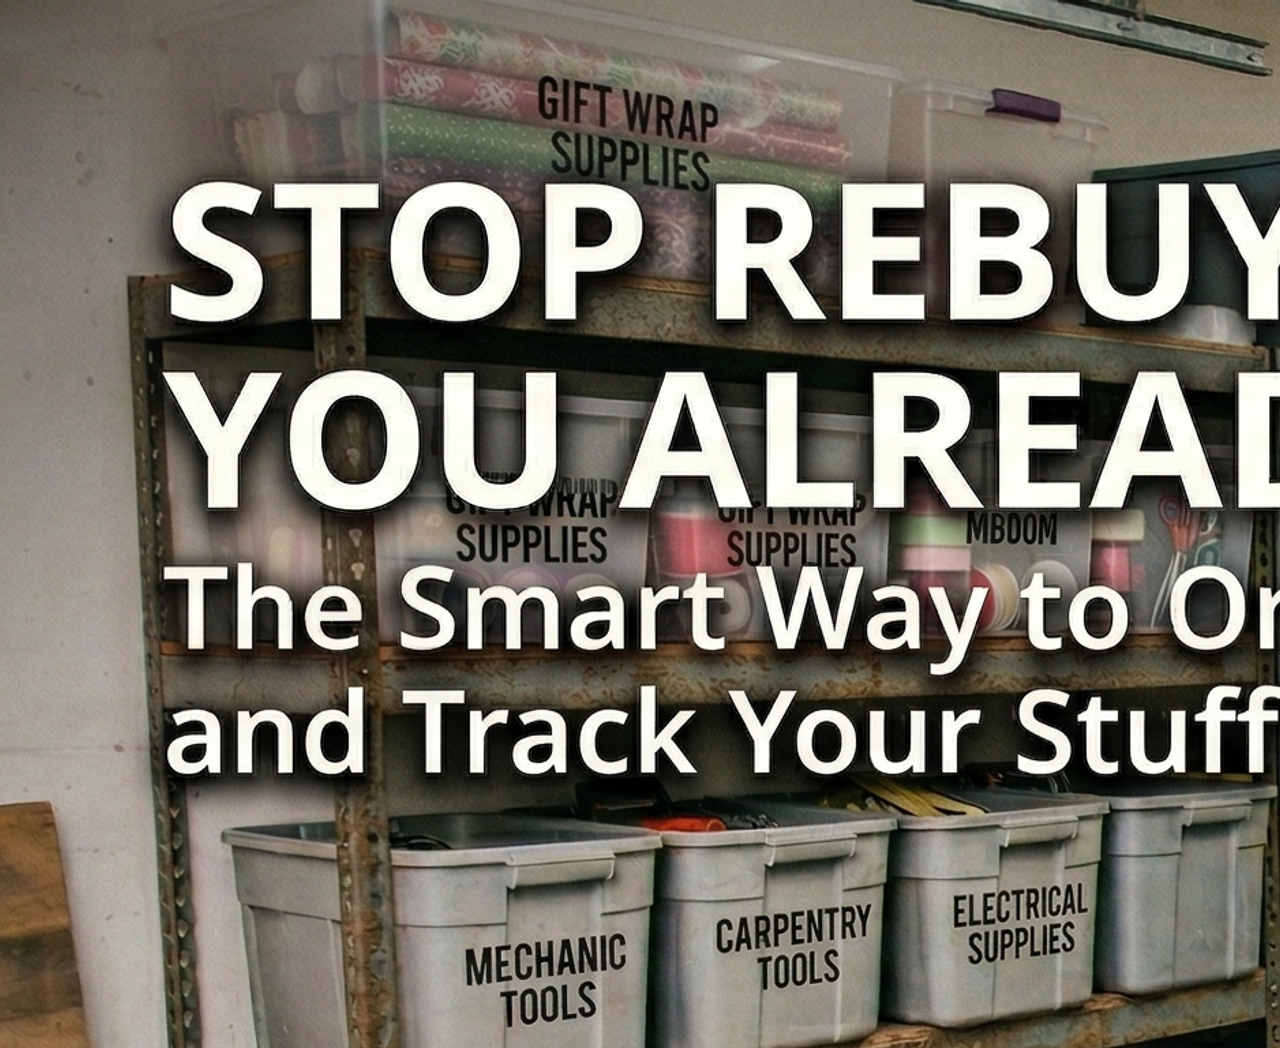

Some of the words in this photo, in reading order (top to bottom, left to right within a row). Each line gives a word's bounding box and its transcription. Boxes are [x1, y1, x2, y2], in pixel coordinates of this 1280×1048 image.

[538, 75, 612, 127] GIFT
[623, 89, 719, 143] WRAP
[551, 130, 710, 192] SUPPLIES
[456, 523, 607, 563] SUPPLIES
[727, 530, 857, 567] SUPPLIES
[966, 511, 1057, 545] MBOOM
[953, 882, 1088, 928] ELECTRICAL
[715, 903, 872, 955] CARPENTRY
[968, 921, 1075, 964] SUPPLIES
[465, 933, 627, 986] MECHANIC
[757, 949, 840, 990] TOOLS
[500, 981, 597, 1027] TOOLS
